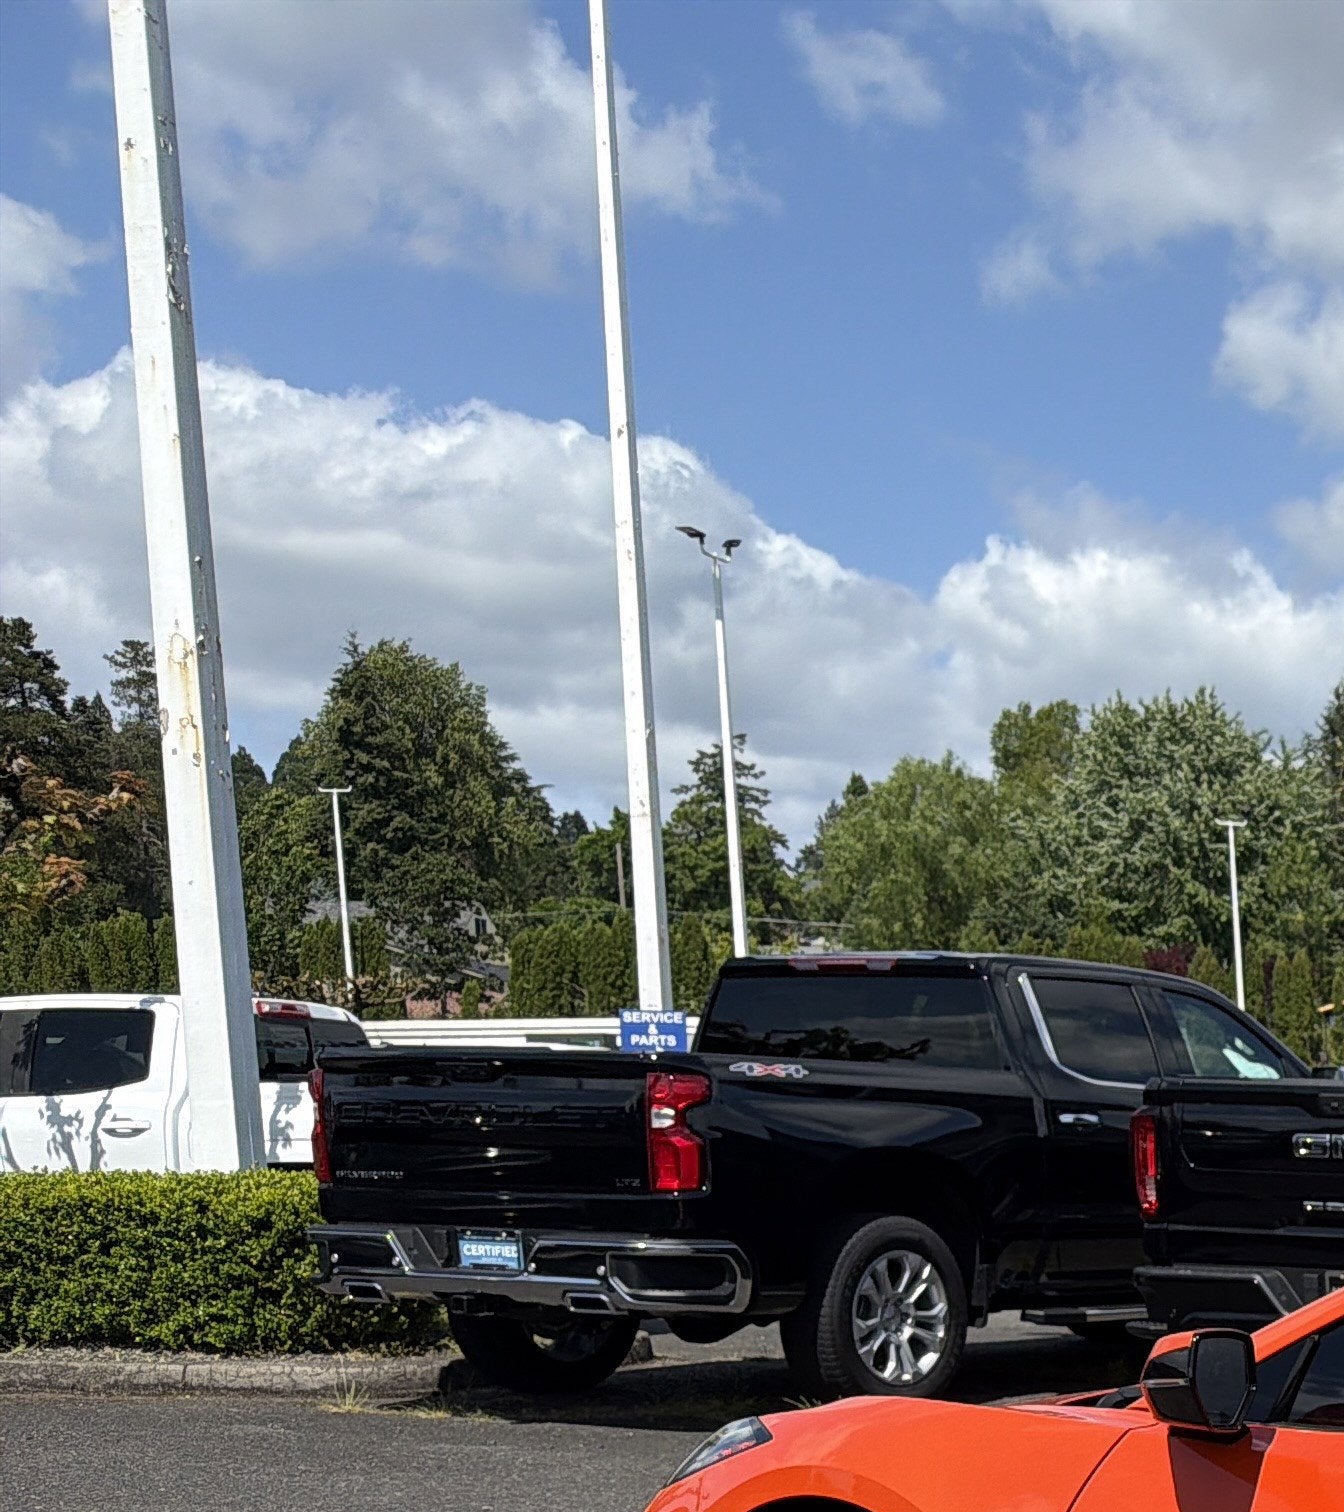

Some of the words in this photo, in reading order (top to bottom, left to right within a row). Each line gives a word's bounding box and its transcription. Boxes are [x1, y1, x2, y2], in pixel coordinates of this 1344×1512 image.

[622, 1010, 683, 1024] SERVICE
[647, 1023, 659, 1035] &
[630, 1034, 677, 1047] PARTS
